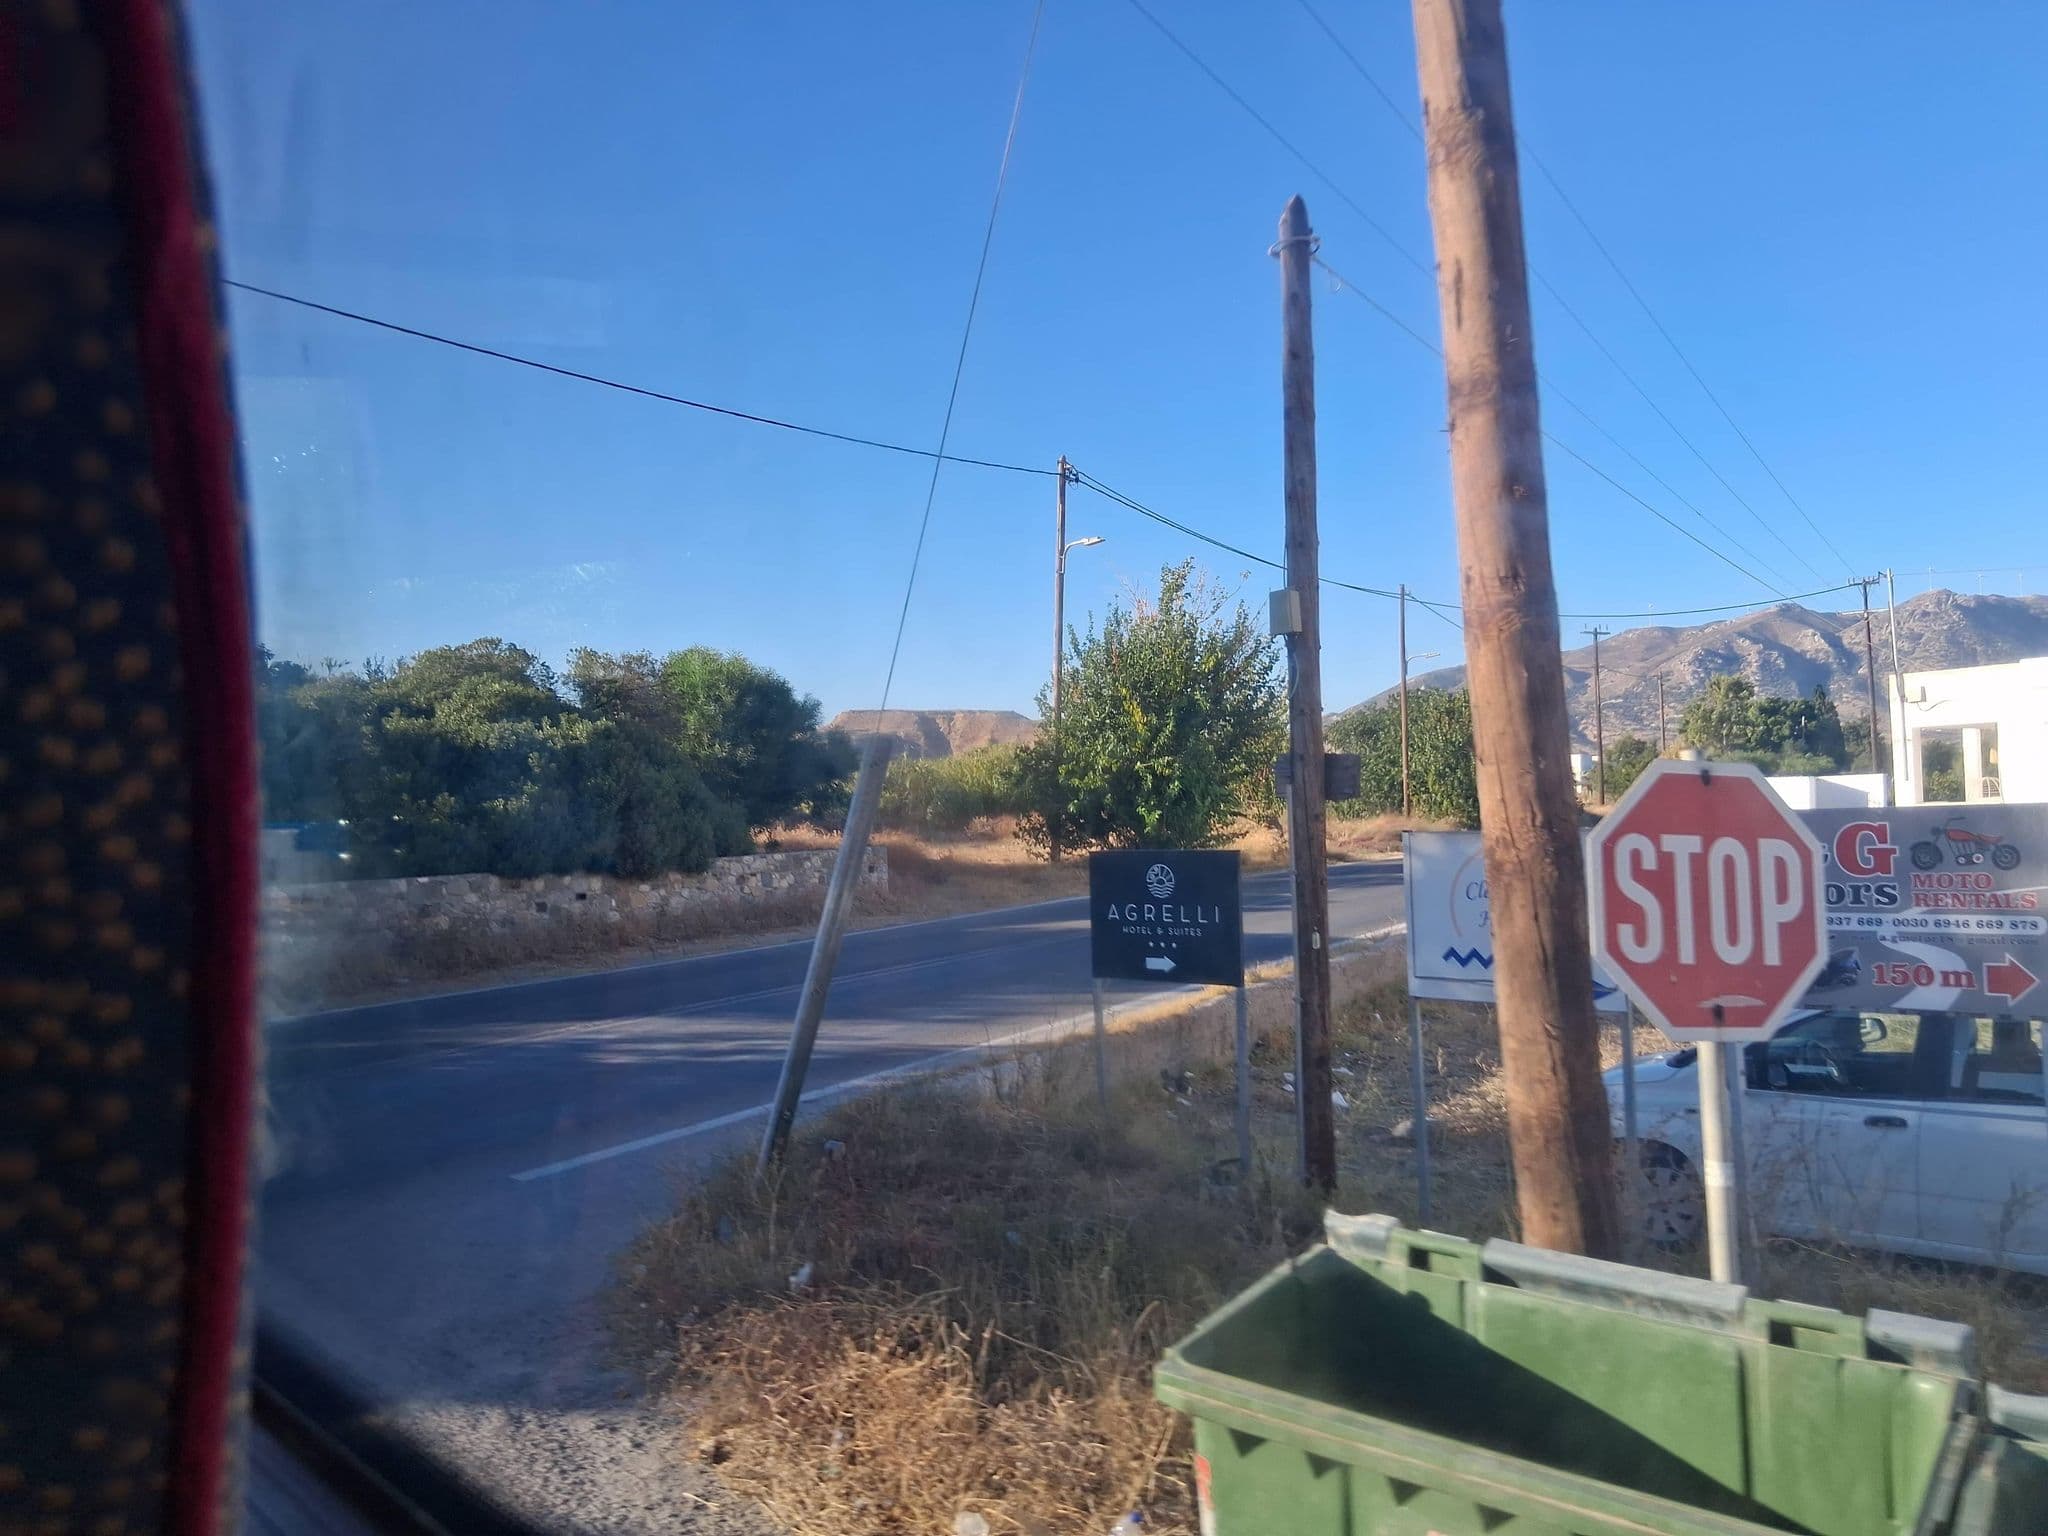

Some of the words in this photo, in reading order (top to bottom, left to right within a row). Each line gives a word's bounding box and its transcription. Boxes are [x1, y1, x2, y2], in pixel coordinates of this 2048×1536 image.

[1911, 871, 1994, 890] MOTO
[1613, 832, 1804, 967] STOP
[1824, 882, 1899, 908] ors
[1912, 890, 2038, 911] RENTALS
[1107, 903, 1220, 924] AGRELLI
[1122, 925, 1152, 936] HOTEL
[1168, 926, 1202, 938] SUITES
